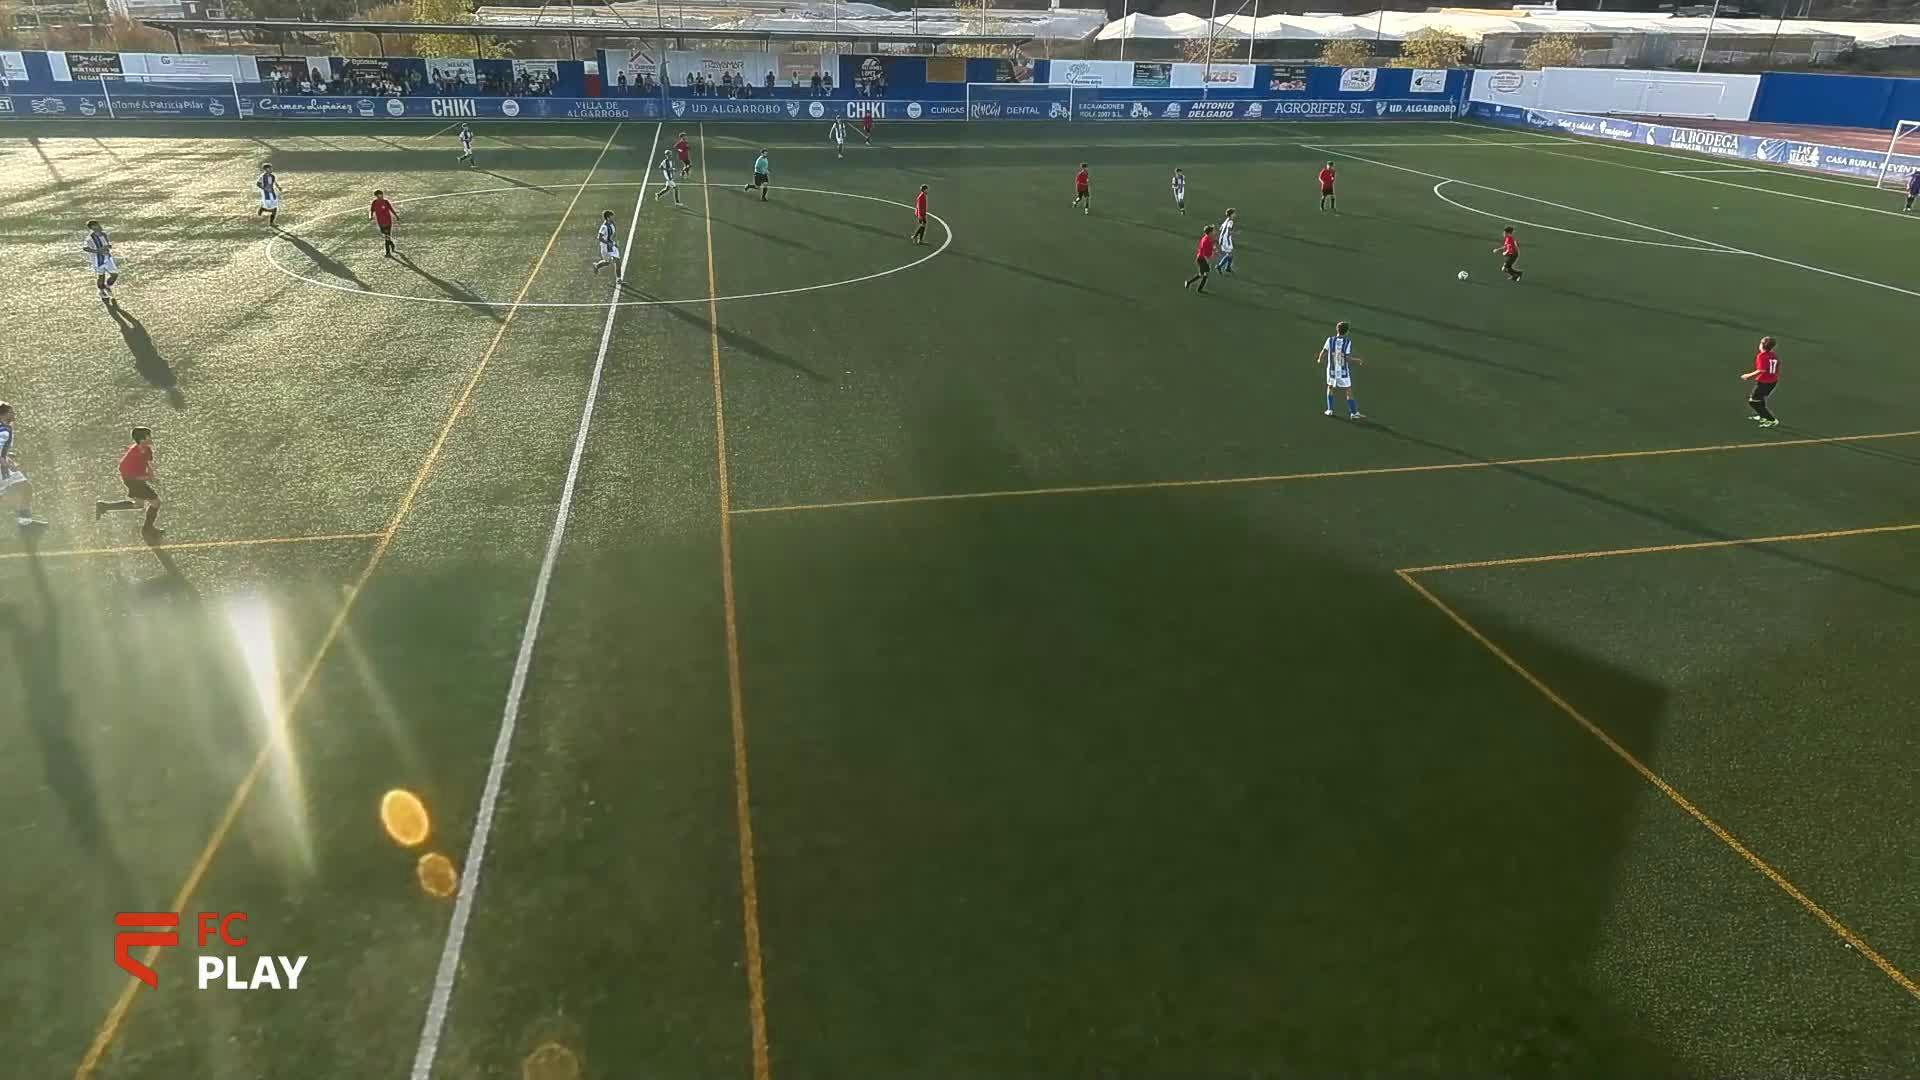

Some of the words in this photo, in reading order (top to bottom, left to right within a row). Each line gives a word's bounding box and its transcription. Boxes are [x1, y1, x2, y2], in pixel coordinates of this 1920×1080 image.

[259, 98, 305, 110] Carmen
[431, 99, 477, 116] CHIKI
[575, 101, 602, 109] VILLA
[606, 101, 618, 109] DE
[691, 104, 708, 113] UD
[711, 104, 781, 113] ALGARROBO
[1406, 104, 1457, 113] ALGARROBO
[1006, 106, 1040, 114] DENTAL
[1187, 110, 1234, 118] DELGADO
[1671, 129, 1686, 143] LA
[1687, 130, 1739, 149] BODEGA
[1825, 155, 1847, 166] CASA
[1848, 157, 1878, 169] RURAL
